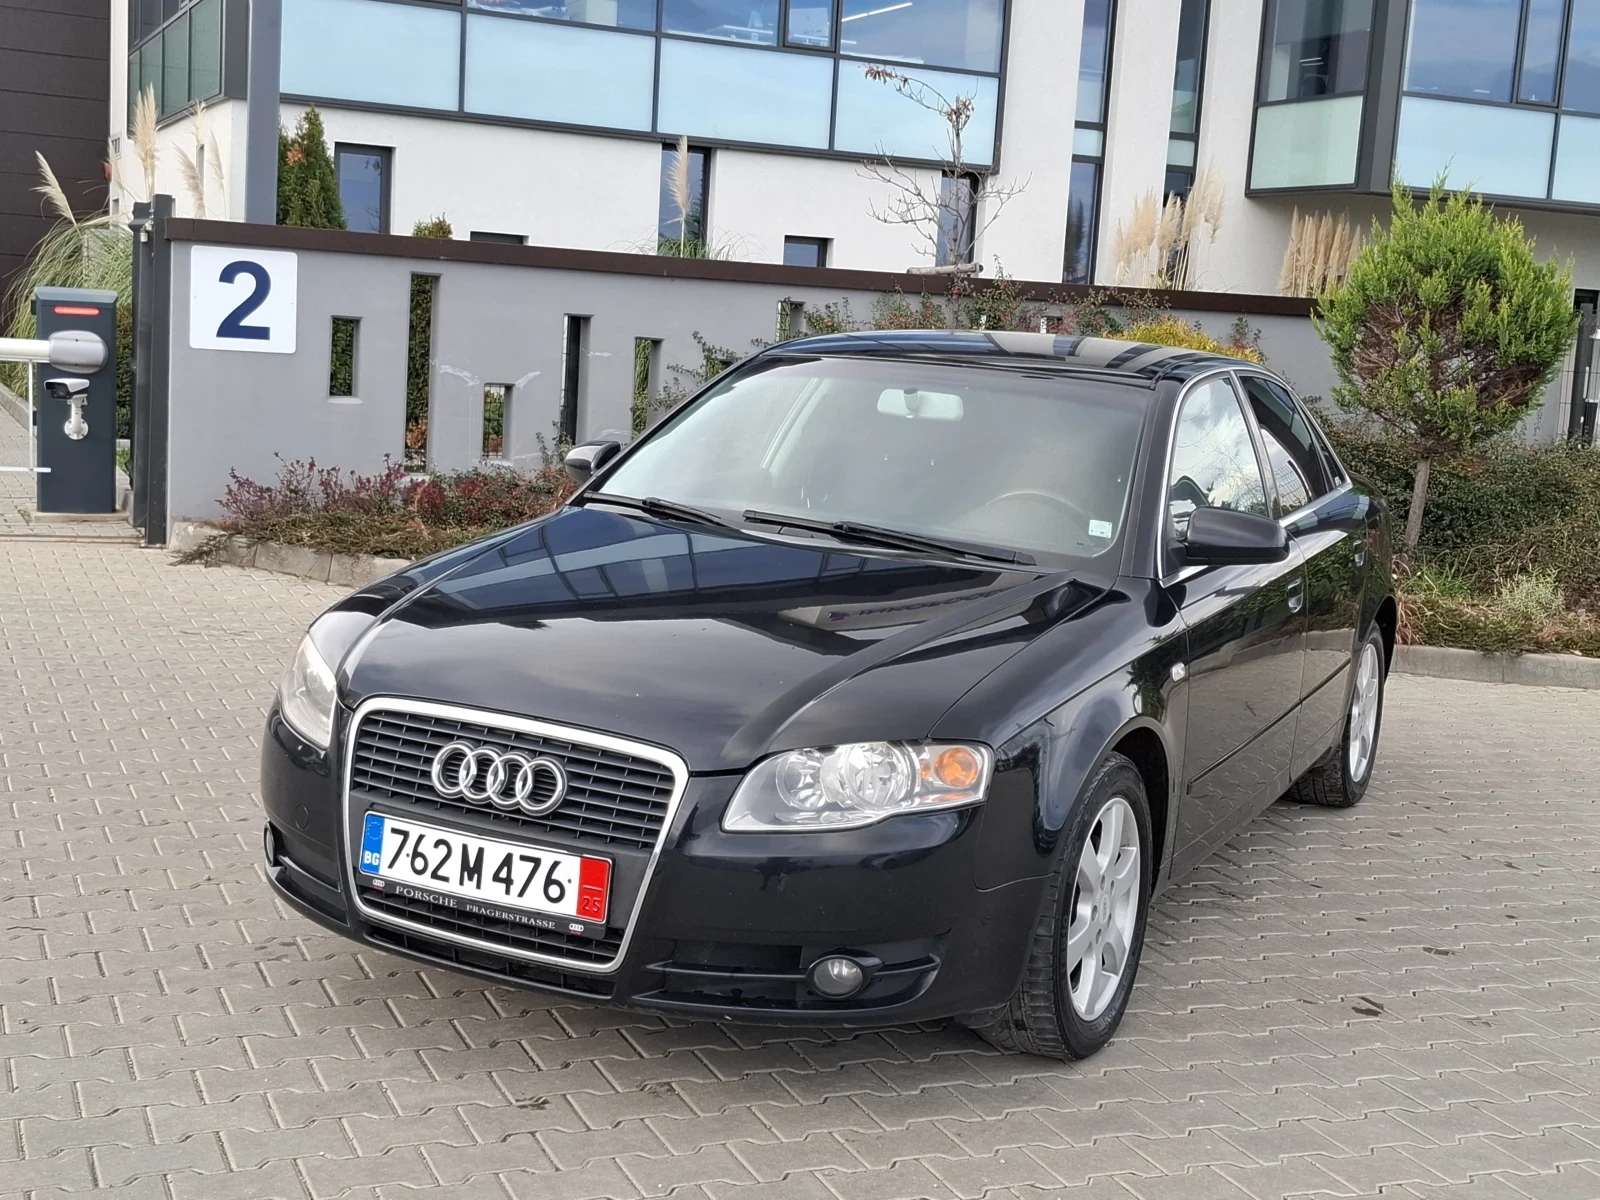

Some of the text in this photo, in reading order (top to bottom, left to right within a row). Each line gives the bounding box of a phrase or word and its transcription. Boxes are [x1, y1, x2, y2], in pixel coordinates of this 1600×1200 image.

[216, 260, 271, 341] 2
[363, 850, 380, 867] BG
[387, 827, 566, 904] 762 M 476
[395, 885, 556, 929] PORSCHE PRAGERSTRASSE
[582, 895, 600, 913] 25
